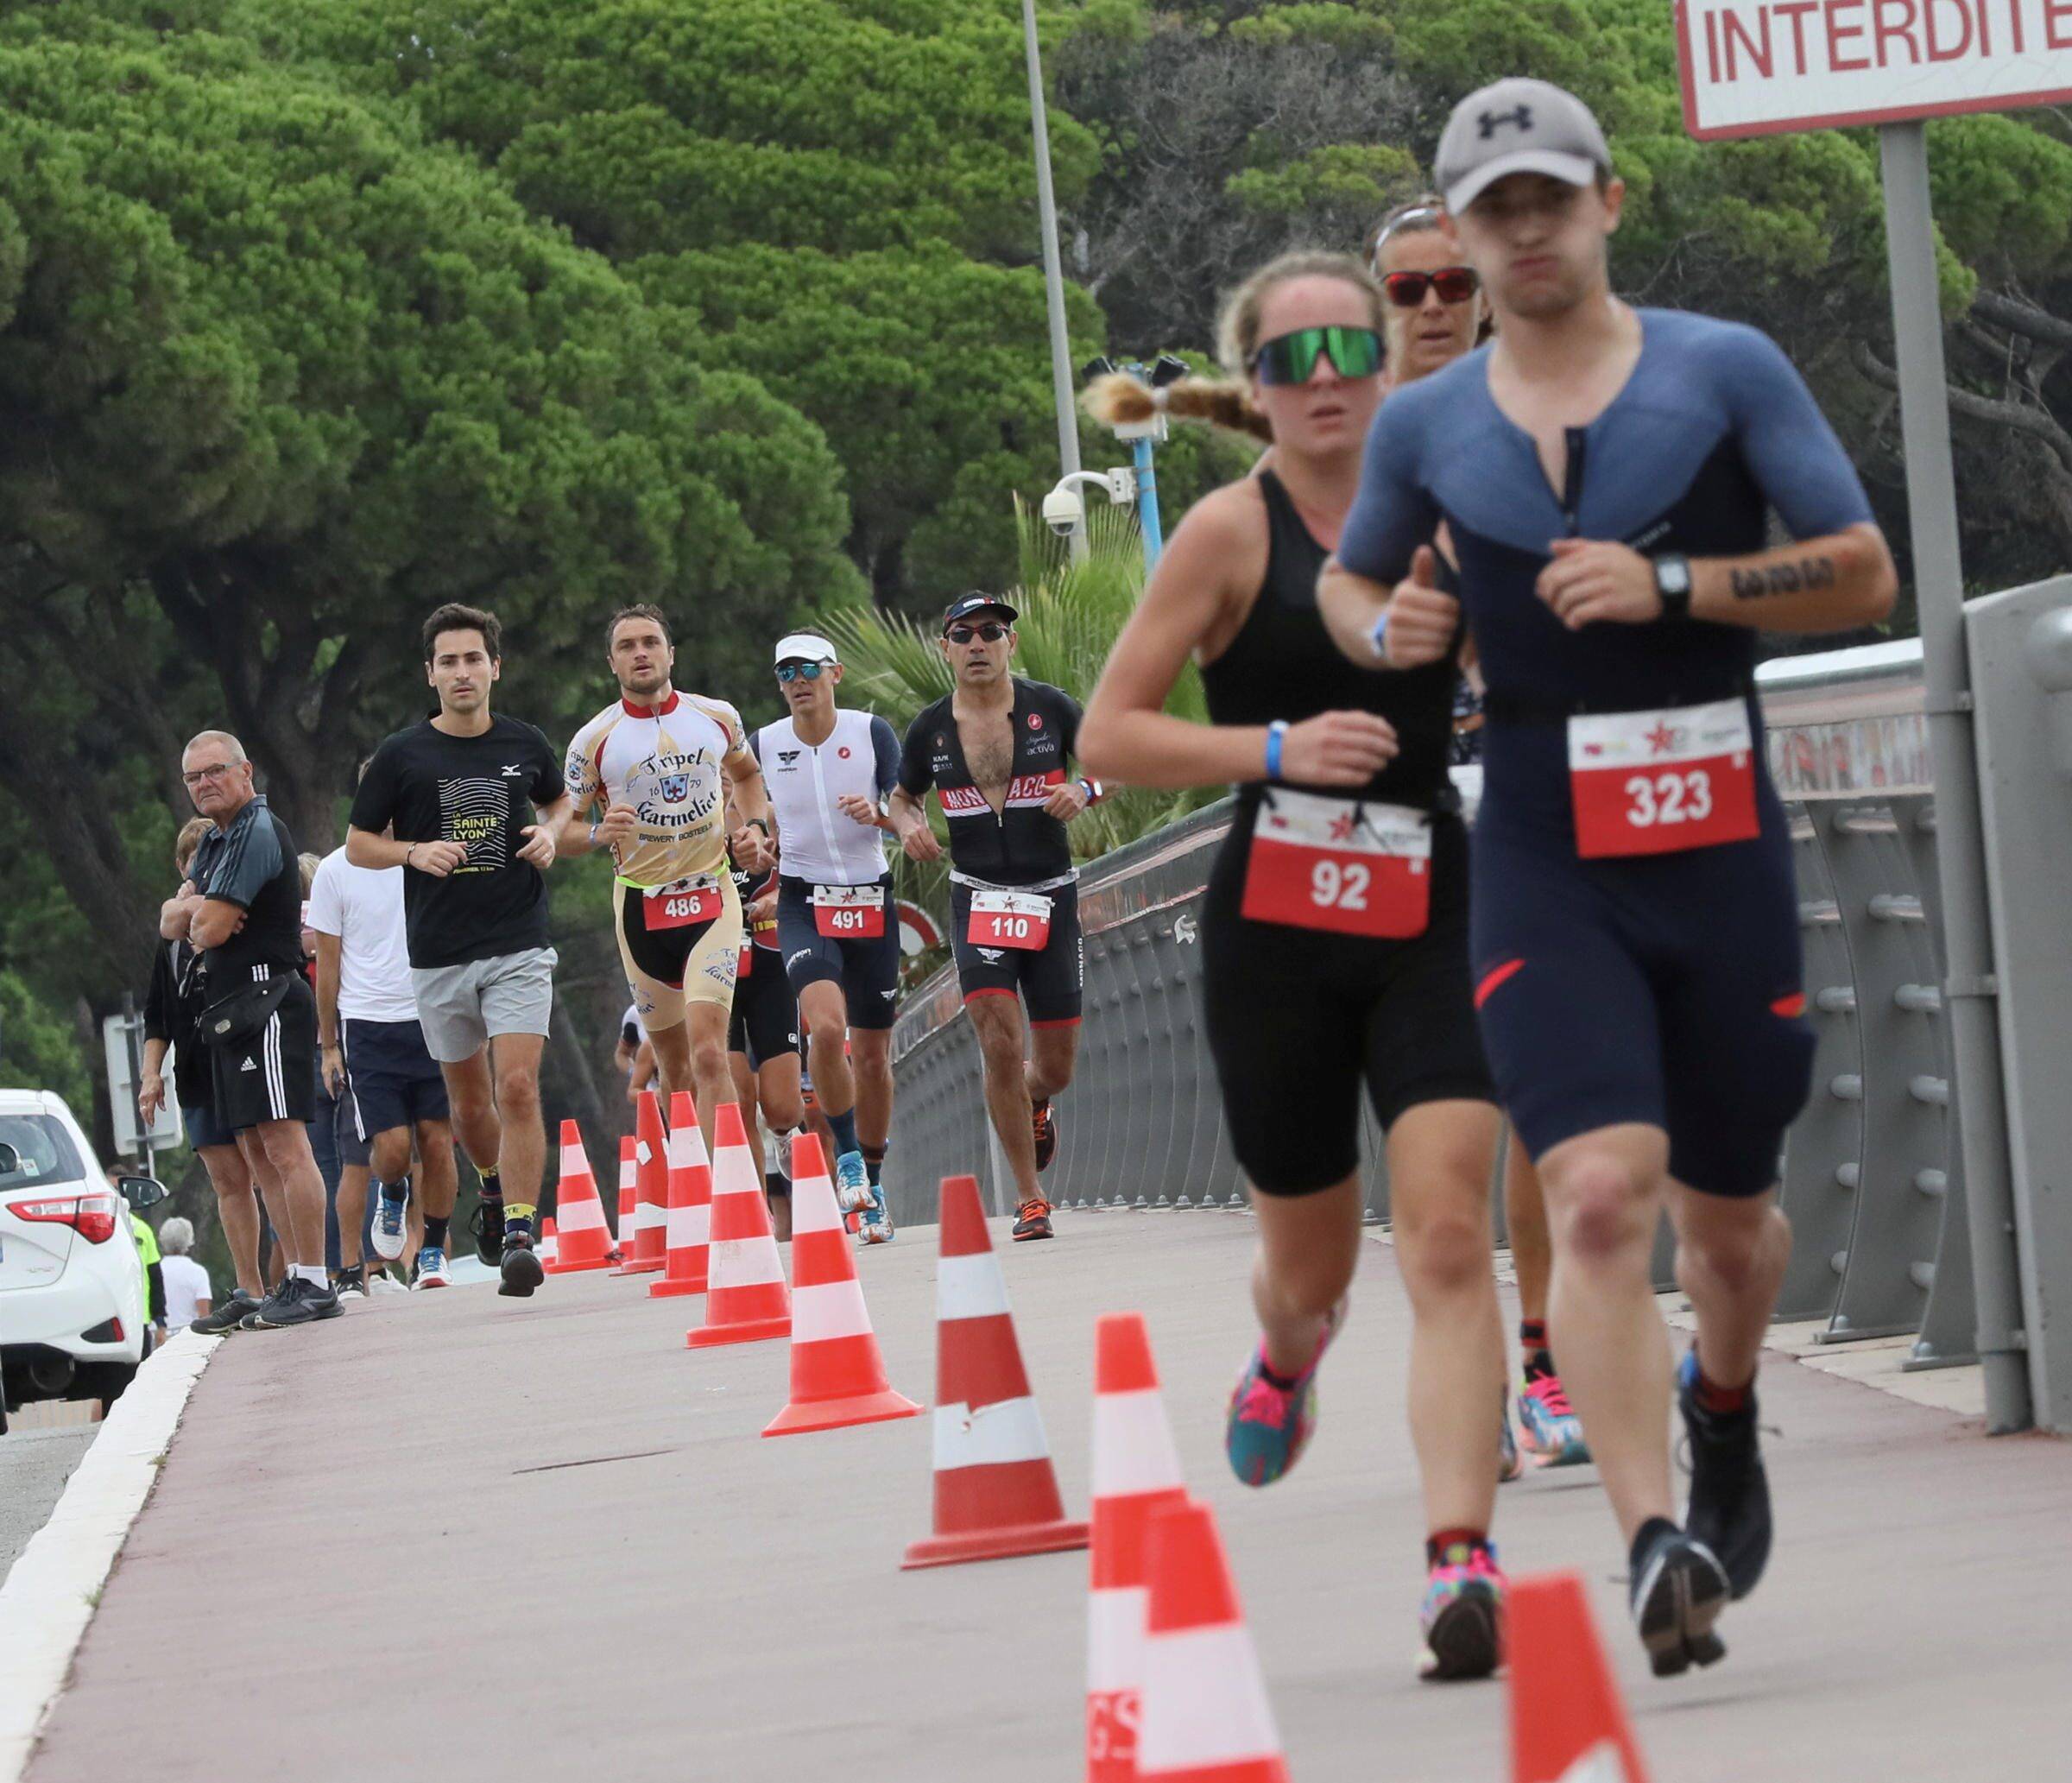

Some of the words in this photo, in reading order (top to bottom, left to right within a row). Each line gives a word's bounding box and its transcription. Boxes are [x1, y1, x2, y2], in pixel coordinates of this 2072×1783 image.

[1703, 0, 2072, 83] INTERDITE
[639, 746, 705, 775] Tripel
[649, 787, 660, 797] 16
[690, 779, 702, 788] 79
[1625, 770, 1713, 828] 323
[637, 790, 717, 826] Karmeliet
[453, 814, 497, 829] SAINTÉ
[639, 832, 675, 843] BREWERY
[679, 822, 713, 841] BOSTEELS
[453, 829, 486, 840] LYON
[1311, 860, 1371, 910] 92
[665, 895, 702, 918] 486
[831, 910, 863, 929] 491
[991, 917, 1028, 939] 110
